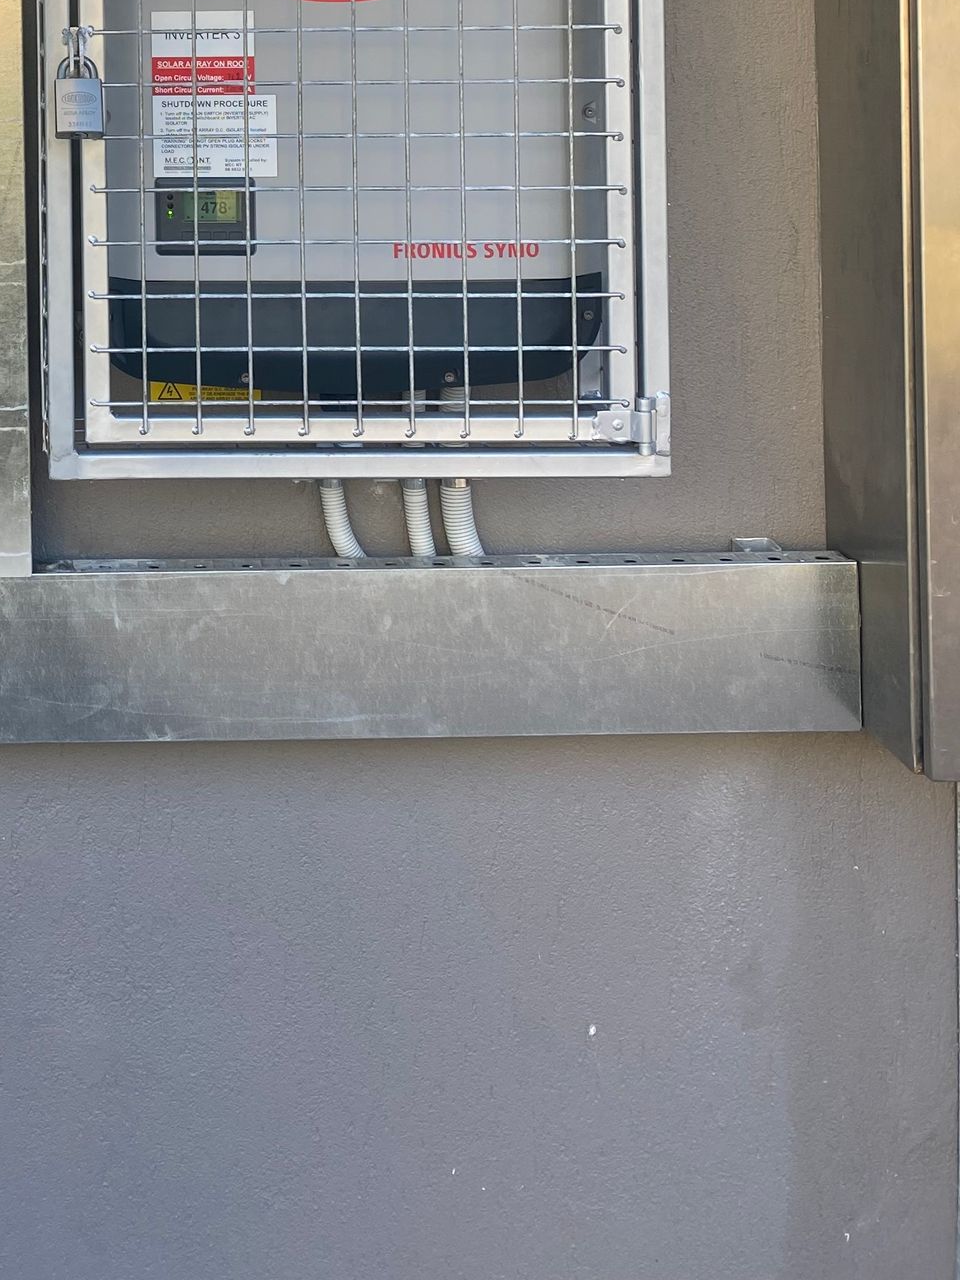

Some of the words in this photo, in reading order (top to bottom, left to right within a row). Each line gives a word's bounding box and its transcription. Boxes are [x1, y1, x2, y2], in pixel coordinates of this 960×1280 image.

[157, 60, 184, 68] SOLAR
[228, 60, 250, 68] ROO
[154, 74, 173, 82] Open
[197, 74, 224, 82] Voltage:
[213, 100, 268, 108] PROCEURE
[200, 201, 228, 215] 478
[393, 242, 478, 259] FRONIUS
[483, 242, 540, 258] SYMO
